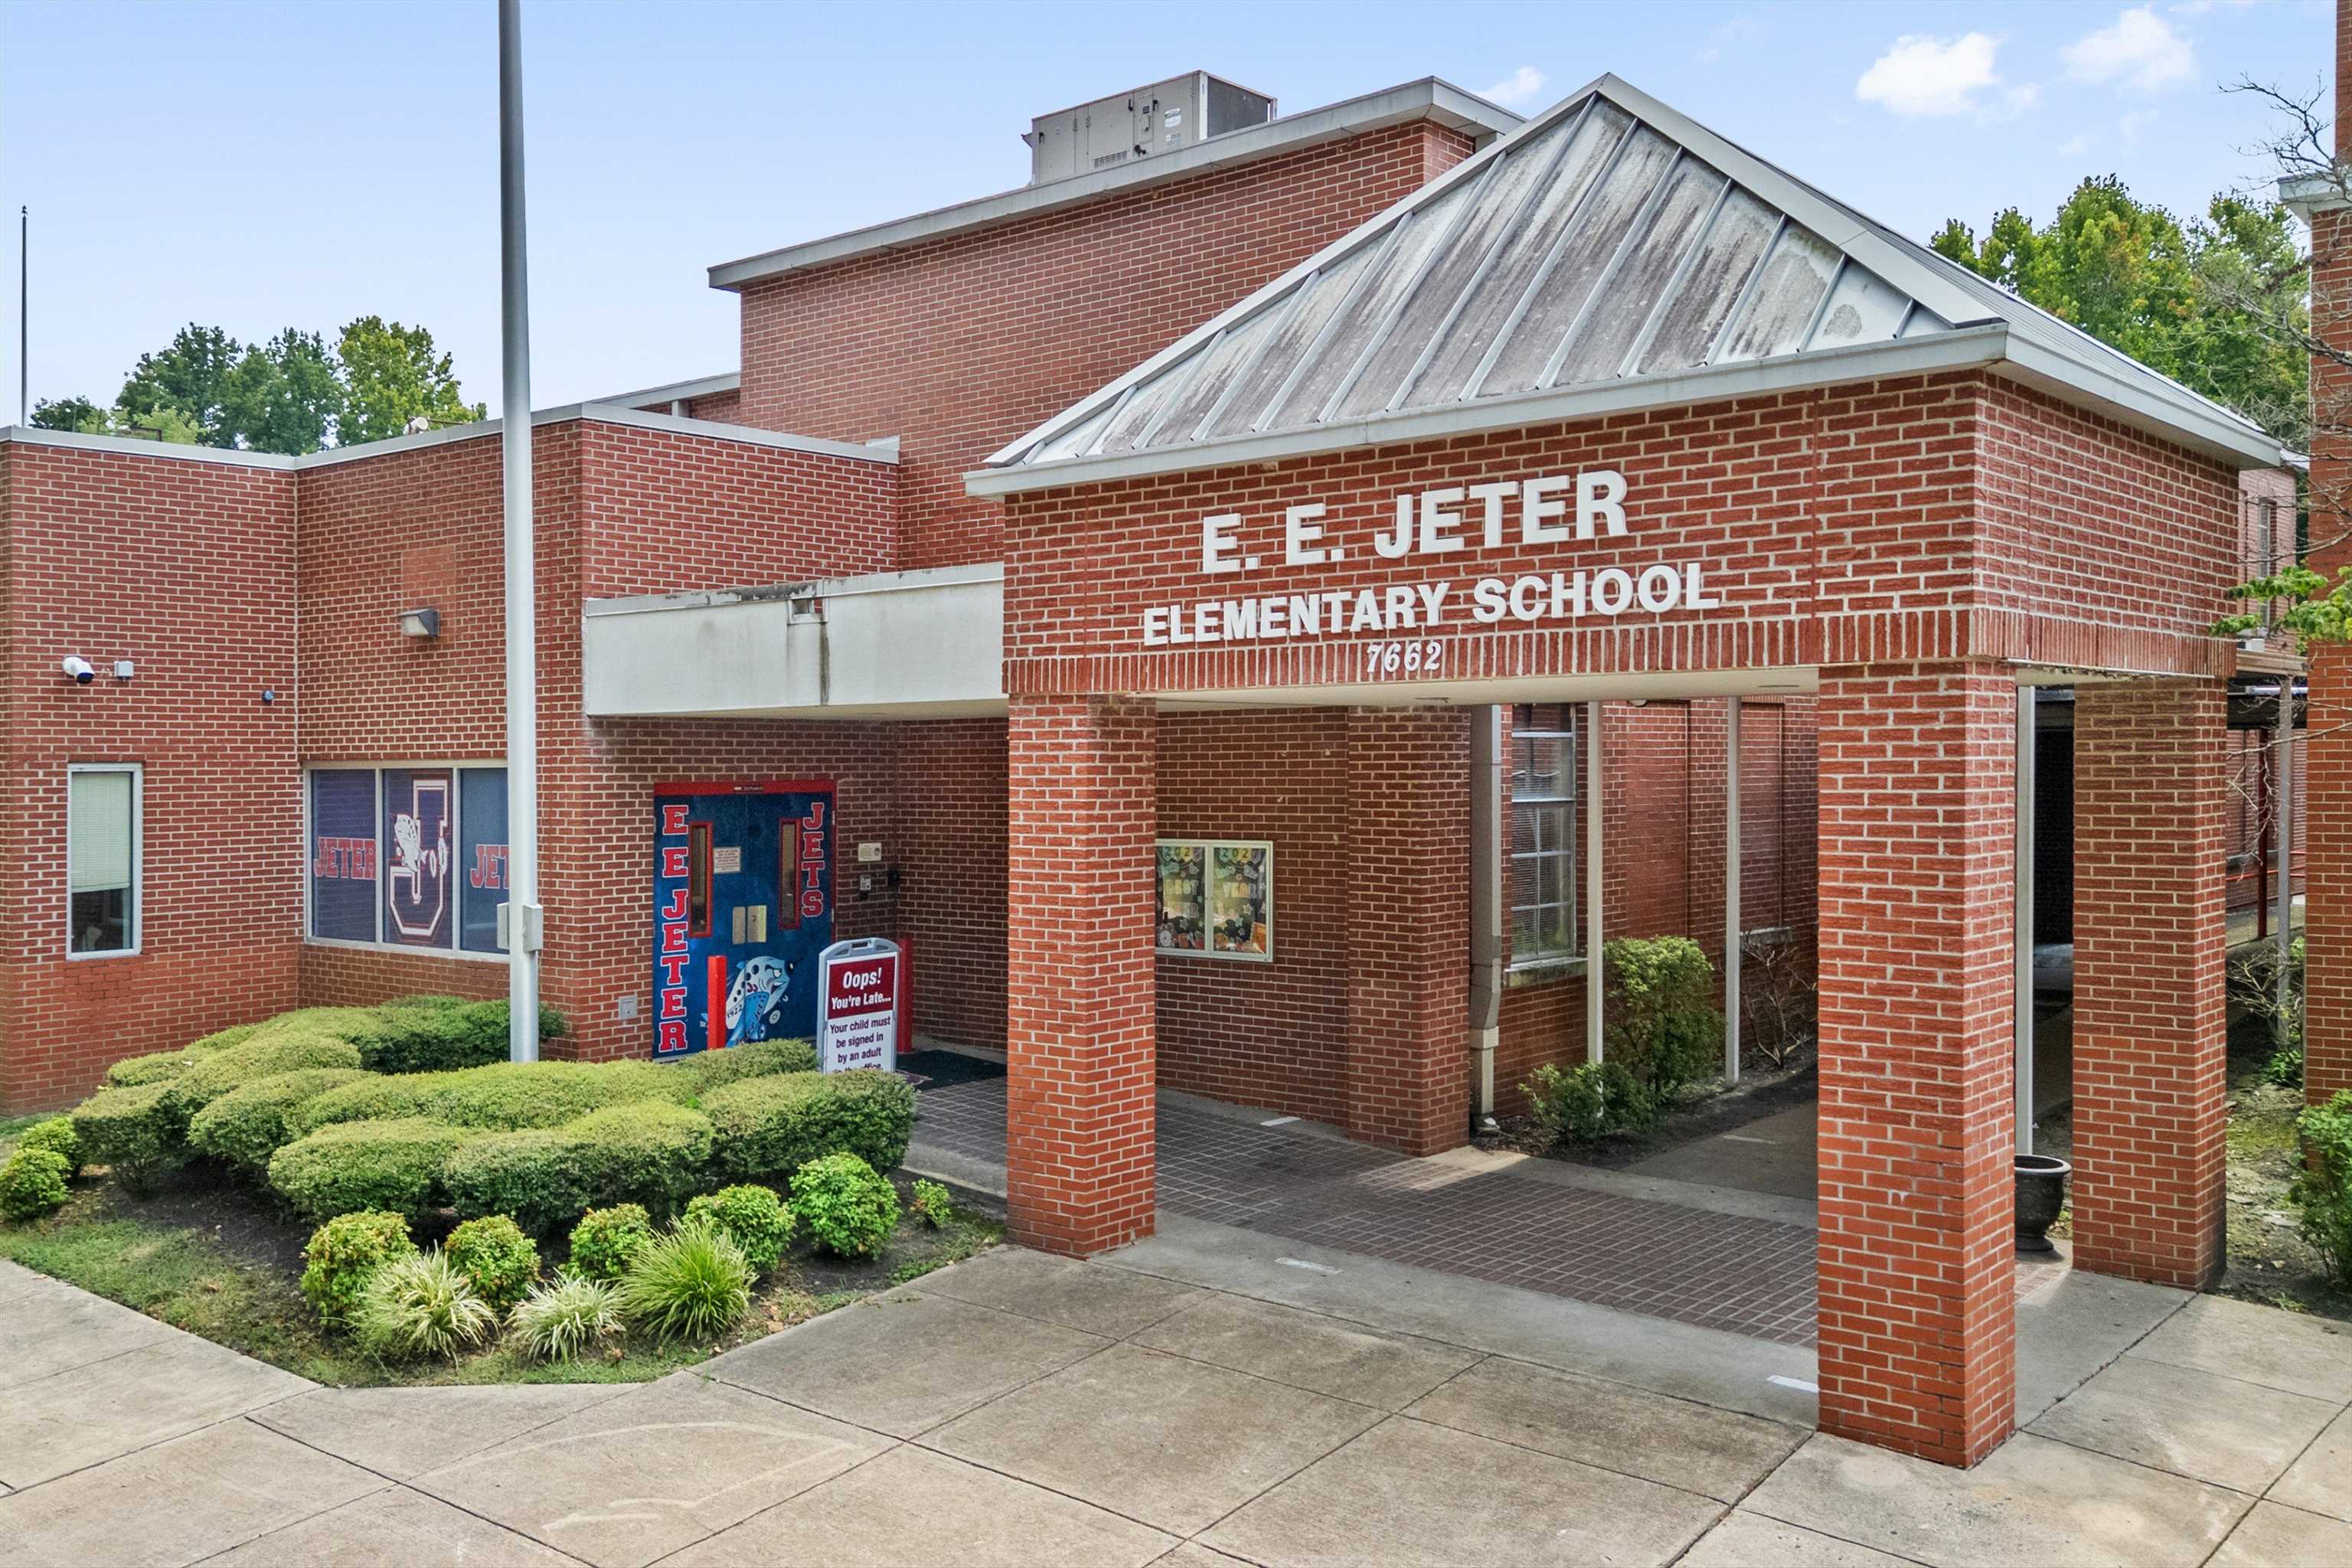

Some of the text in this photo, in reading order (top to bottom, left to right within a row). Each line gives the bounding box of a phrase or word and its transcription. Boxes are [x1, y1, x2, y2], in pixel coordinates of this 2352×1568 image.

[1203, 469, 1630, 575] E. E. JETER
[1143, 563, 1720, 647] ELEMENTARY SCHOOL
[1367, 641, 1442, 674] 7662
[313, 837, 376, 880] JETER
[470, 844, 509, 889] JET
[802, 802, 825, 917] JETS
[658, 805, 688, 1053] E E JETER
[843, 967, 883, 990] Oops!
[831, 991, 891, 1010] You're Late...
[830, 1016, 891, 1034] Your child must
[836, 1032, 884, 1048] be signed in
[838, 1047, 882, 1065] by an adult
